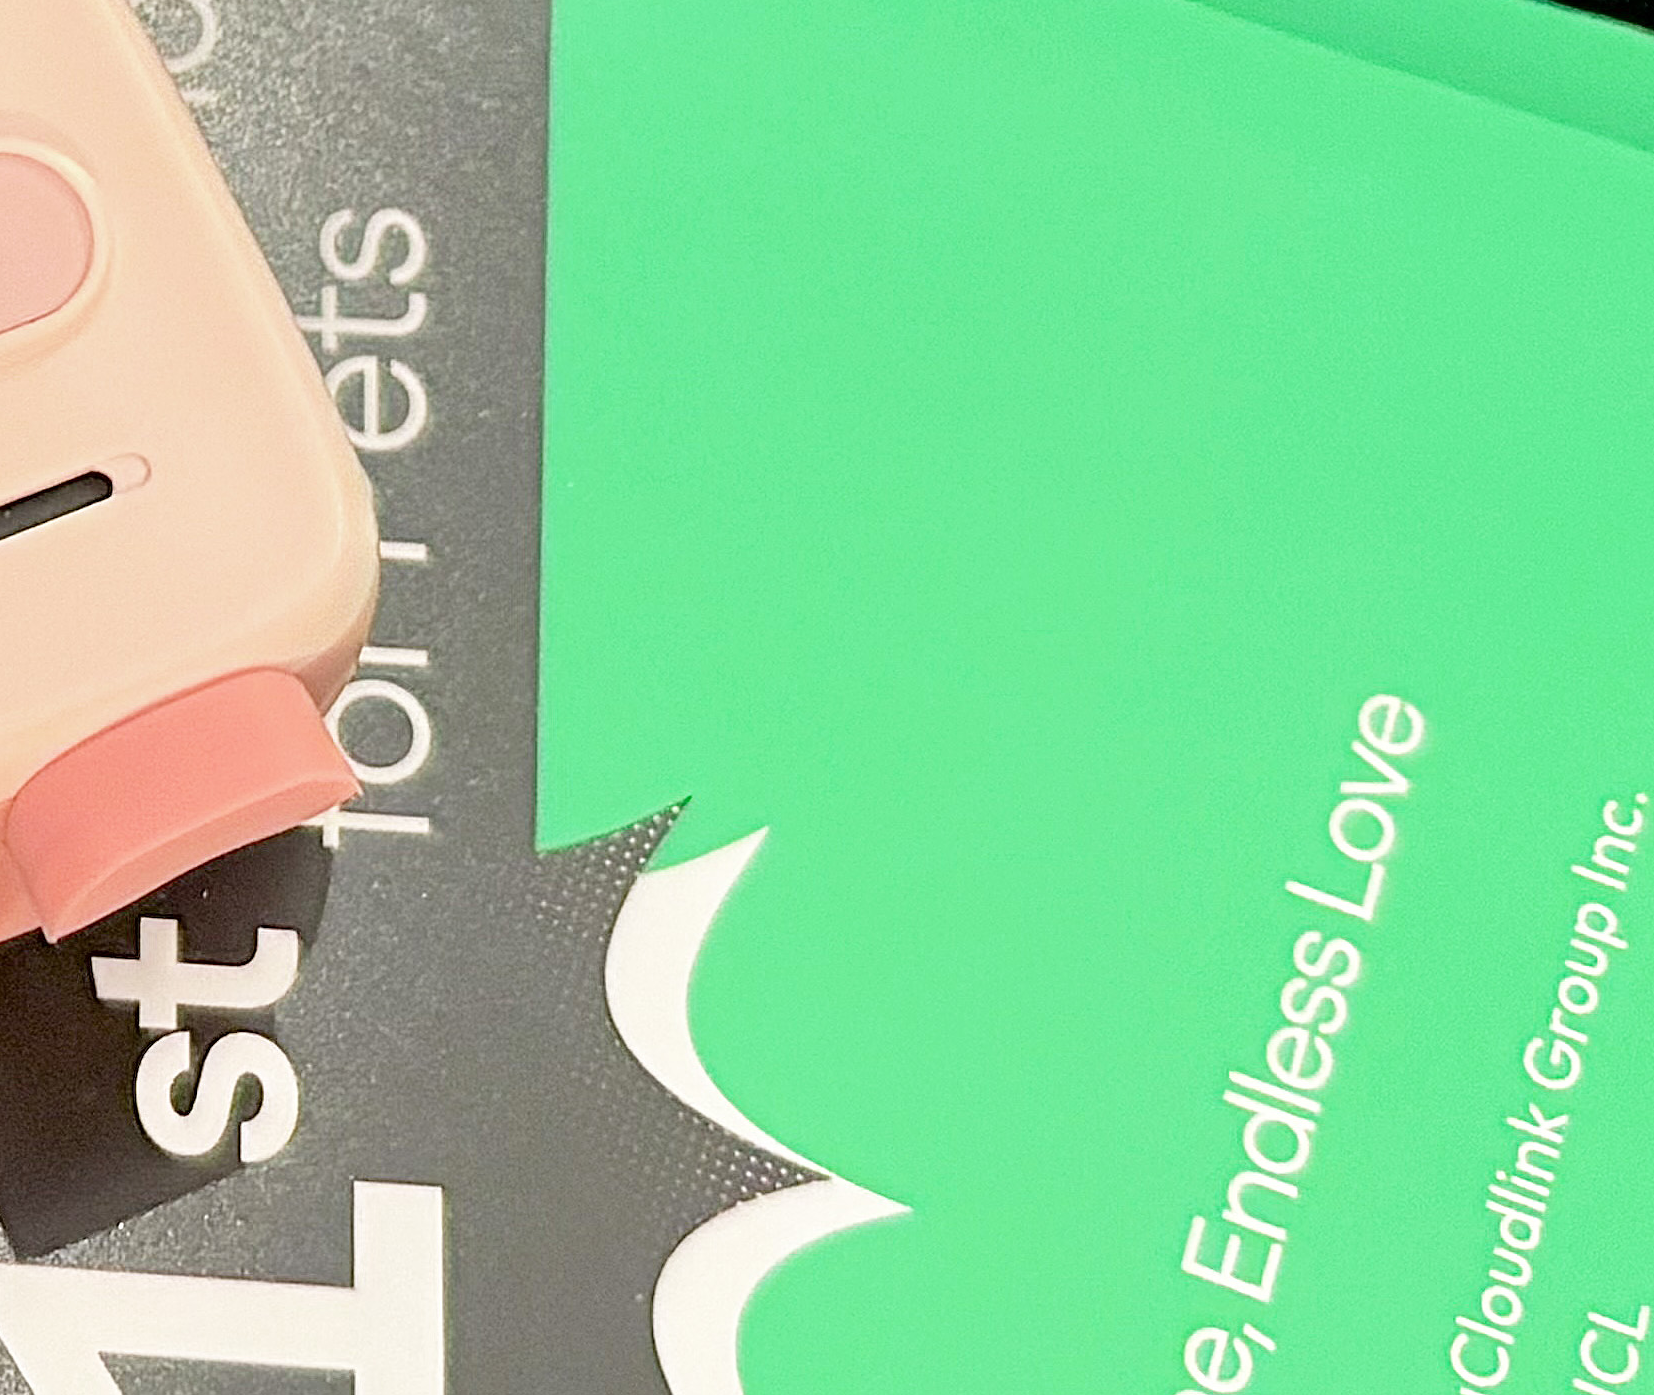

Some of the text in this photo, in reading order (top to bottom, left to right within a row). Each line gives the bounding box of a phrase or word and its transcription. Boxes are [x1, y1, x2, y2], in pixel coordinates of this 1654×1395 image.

[297, 206, 430, 562] ets
[90, 916, 300, 1164] st
[1180, 929, 1364, 1305] Endless
[1285, 692, 1428, 923] Love
[1448, 790, 1650, 1395] Cloudlink Group Inc.
